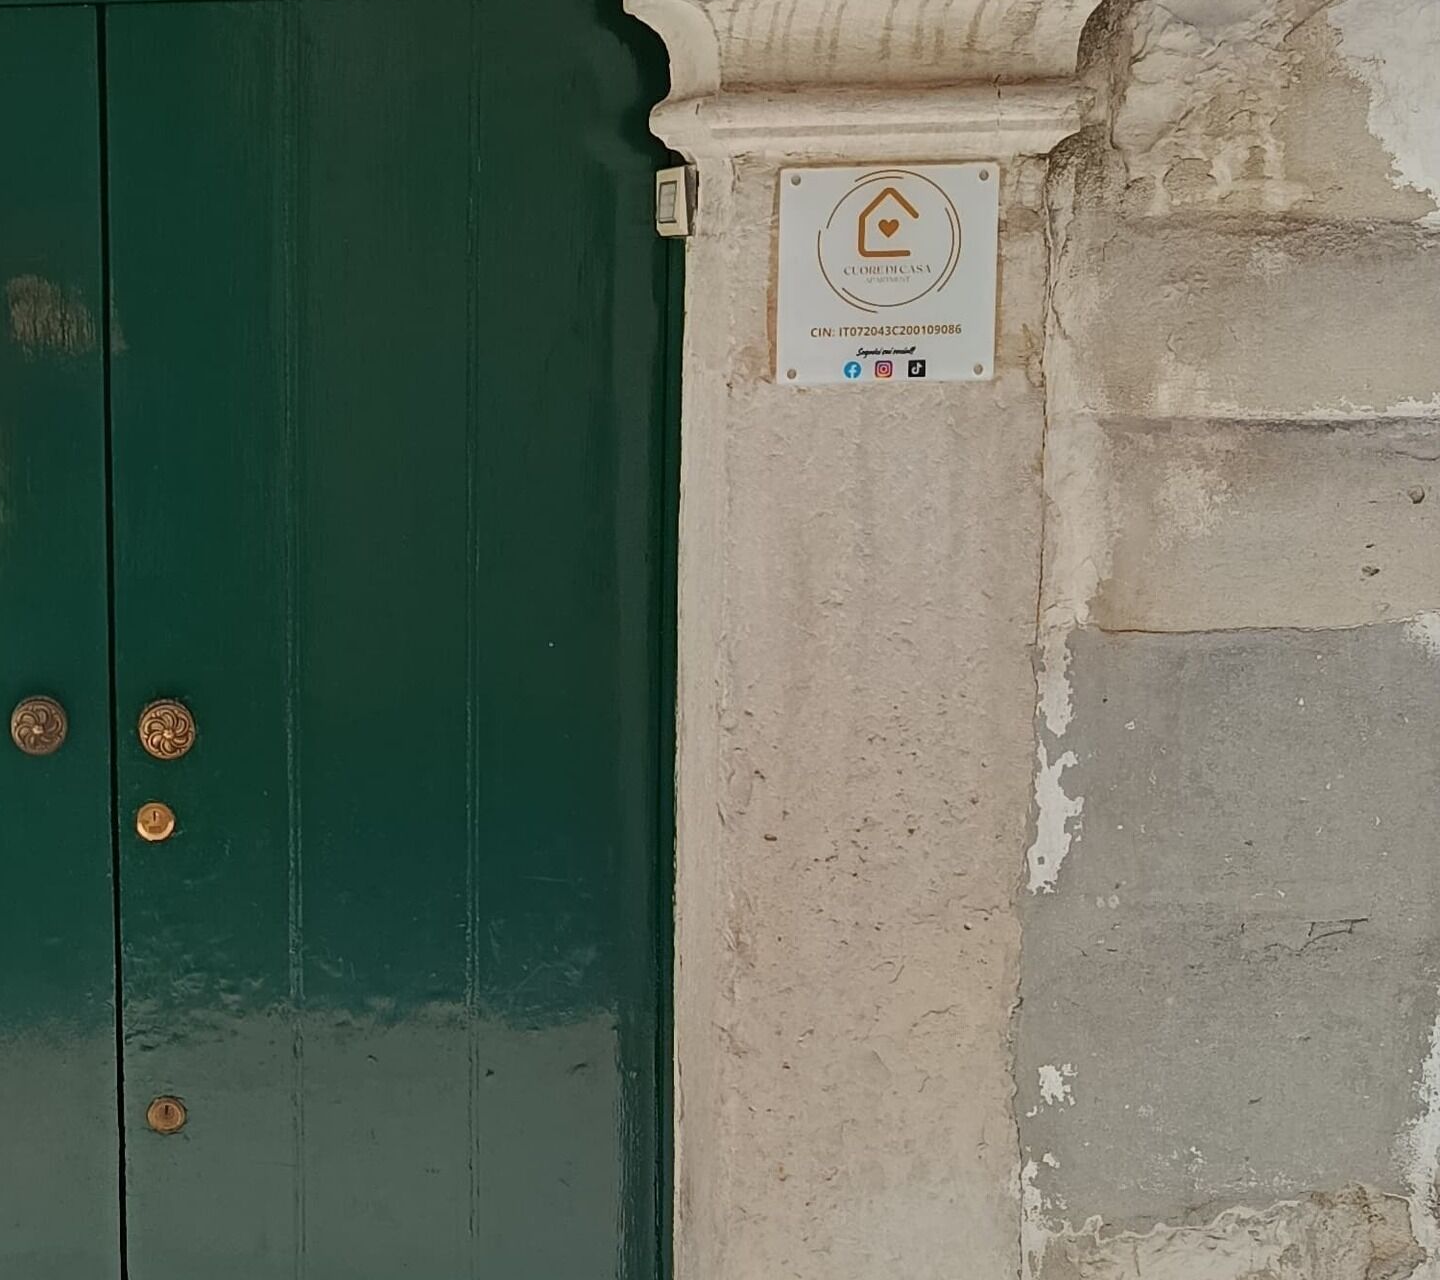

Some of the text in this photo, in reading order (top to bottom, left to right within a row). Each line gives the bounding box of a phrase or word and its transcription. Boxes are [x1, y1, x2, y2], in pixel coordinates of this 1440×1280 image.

[843, 264, 882, 276] CUORE
[898, 264, 932, 274] CASA
[810, 324, 963, 338] CIN: IT072043C200109086
